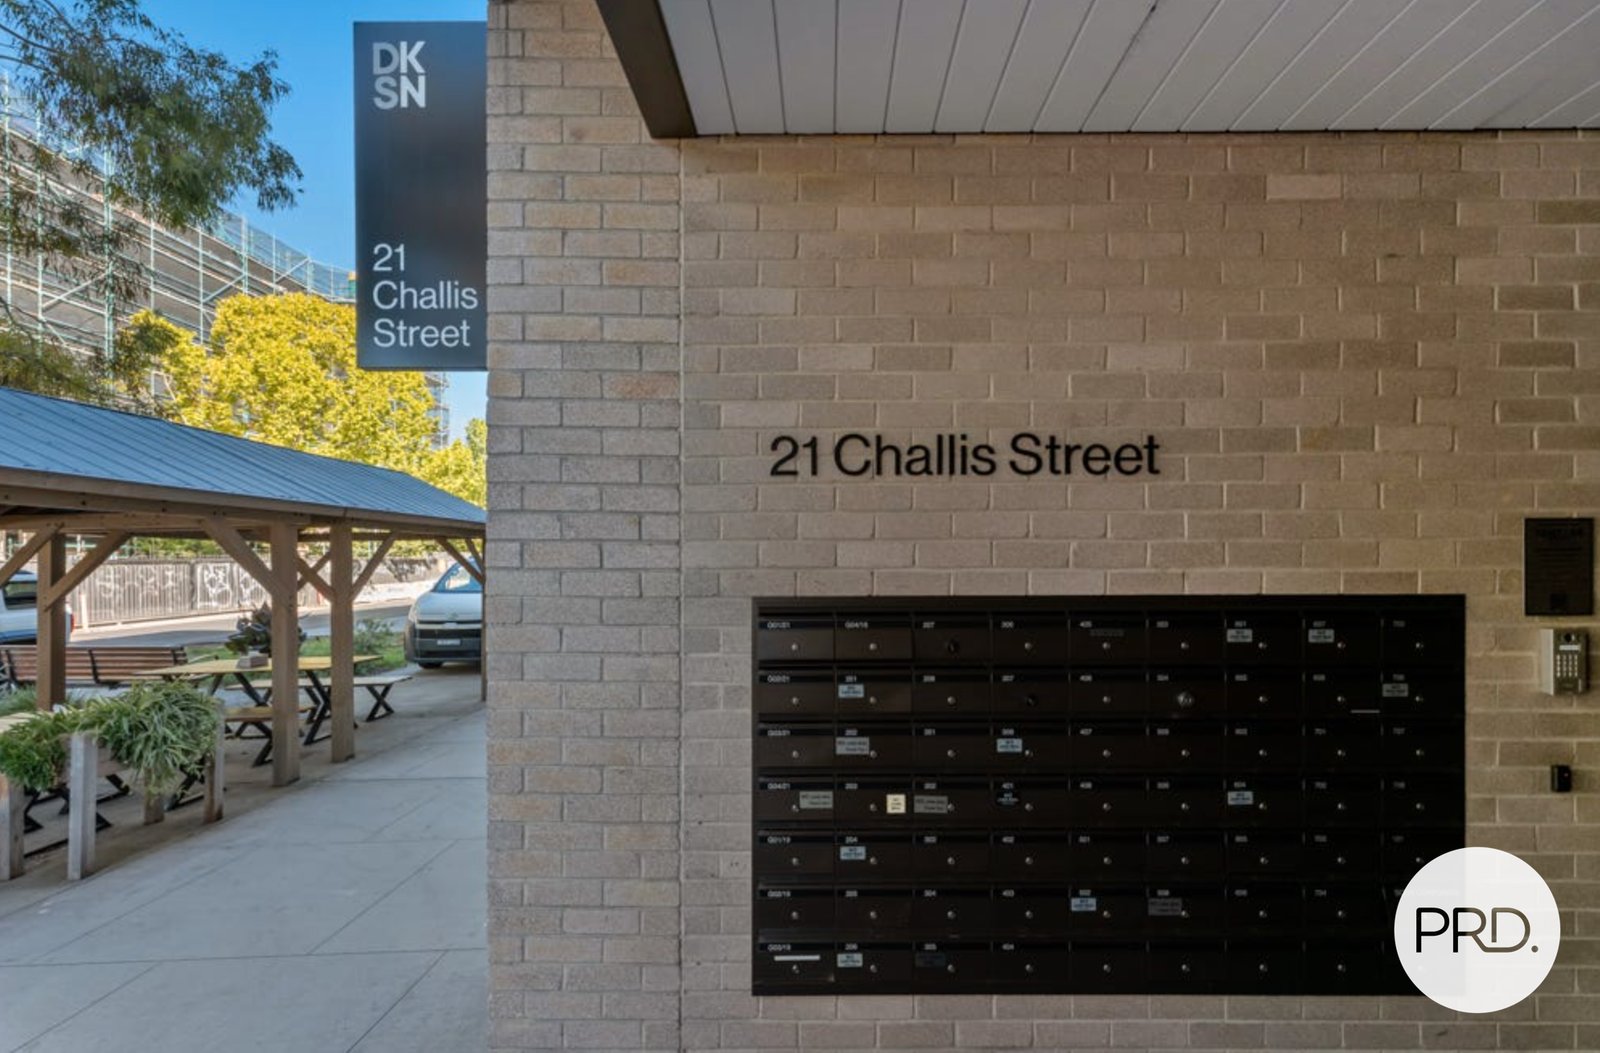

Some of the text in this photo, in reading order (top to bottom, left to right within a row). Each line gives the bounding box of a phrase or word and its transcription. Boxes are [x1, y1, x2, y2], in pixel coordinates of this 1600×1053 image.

[372, 41, 426, 75] DK
[373, 75, 426, 110] SN
[373, 243, 405, 272] 21
[372, 280, 479, 310] Challis
[373, 318, 471, 347] Street
[769, 432, 1161, 477] 21 Challis Street
